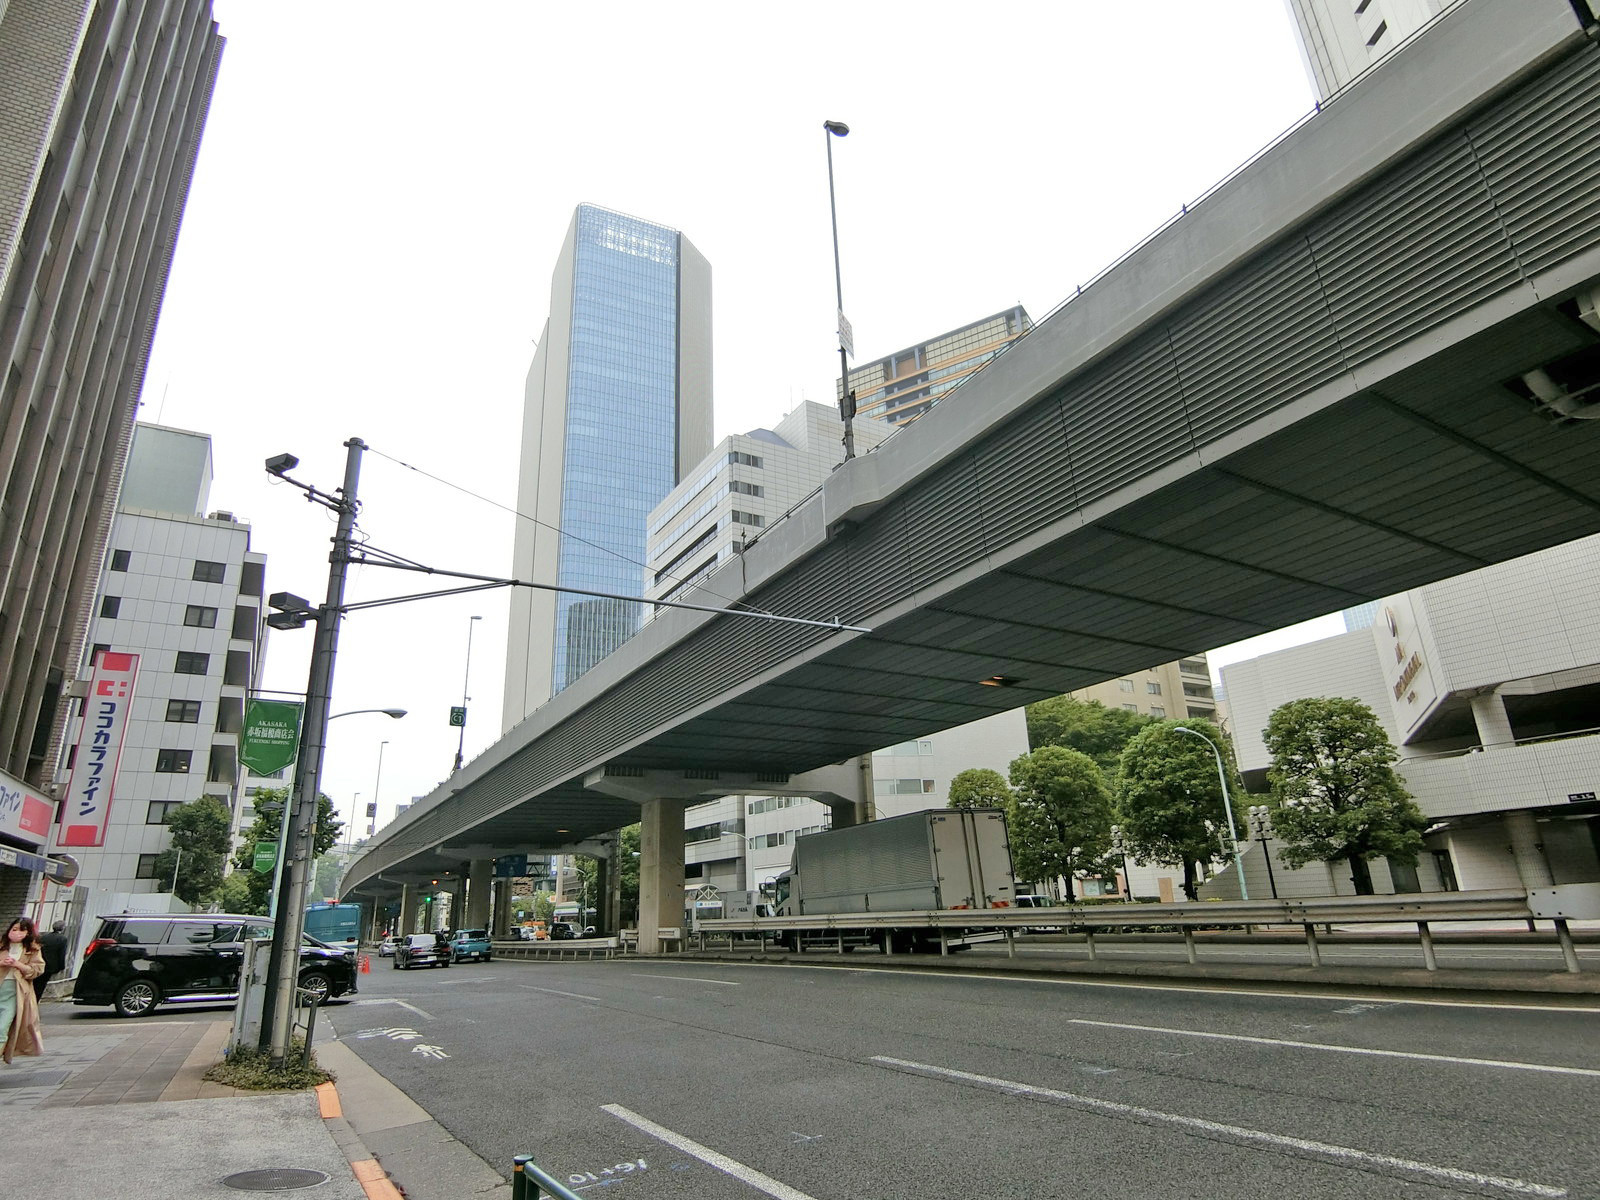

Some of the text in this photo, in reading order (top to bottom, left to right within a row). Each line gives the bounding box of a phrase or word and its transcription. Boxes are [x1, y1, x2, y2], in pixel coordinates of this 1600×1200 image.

[79, 702, 116, 816] ココカラファイン
